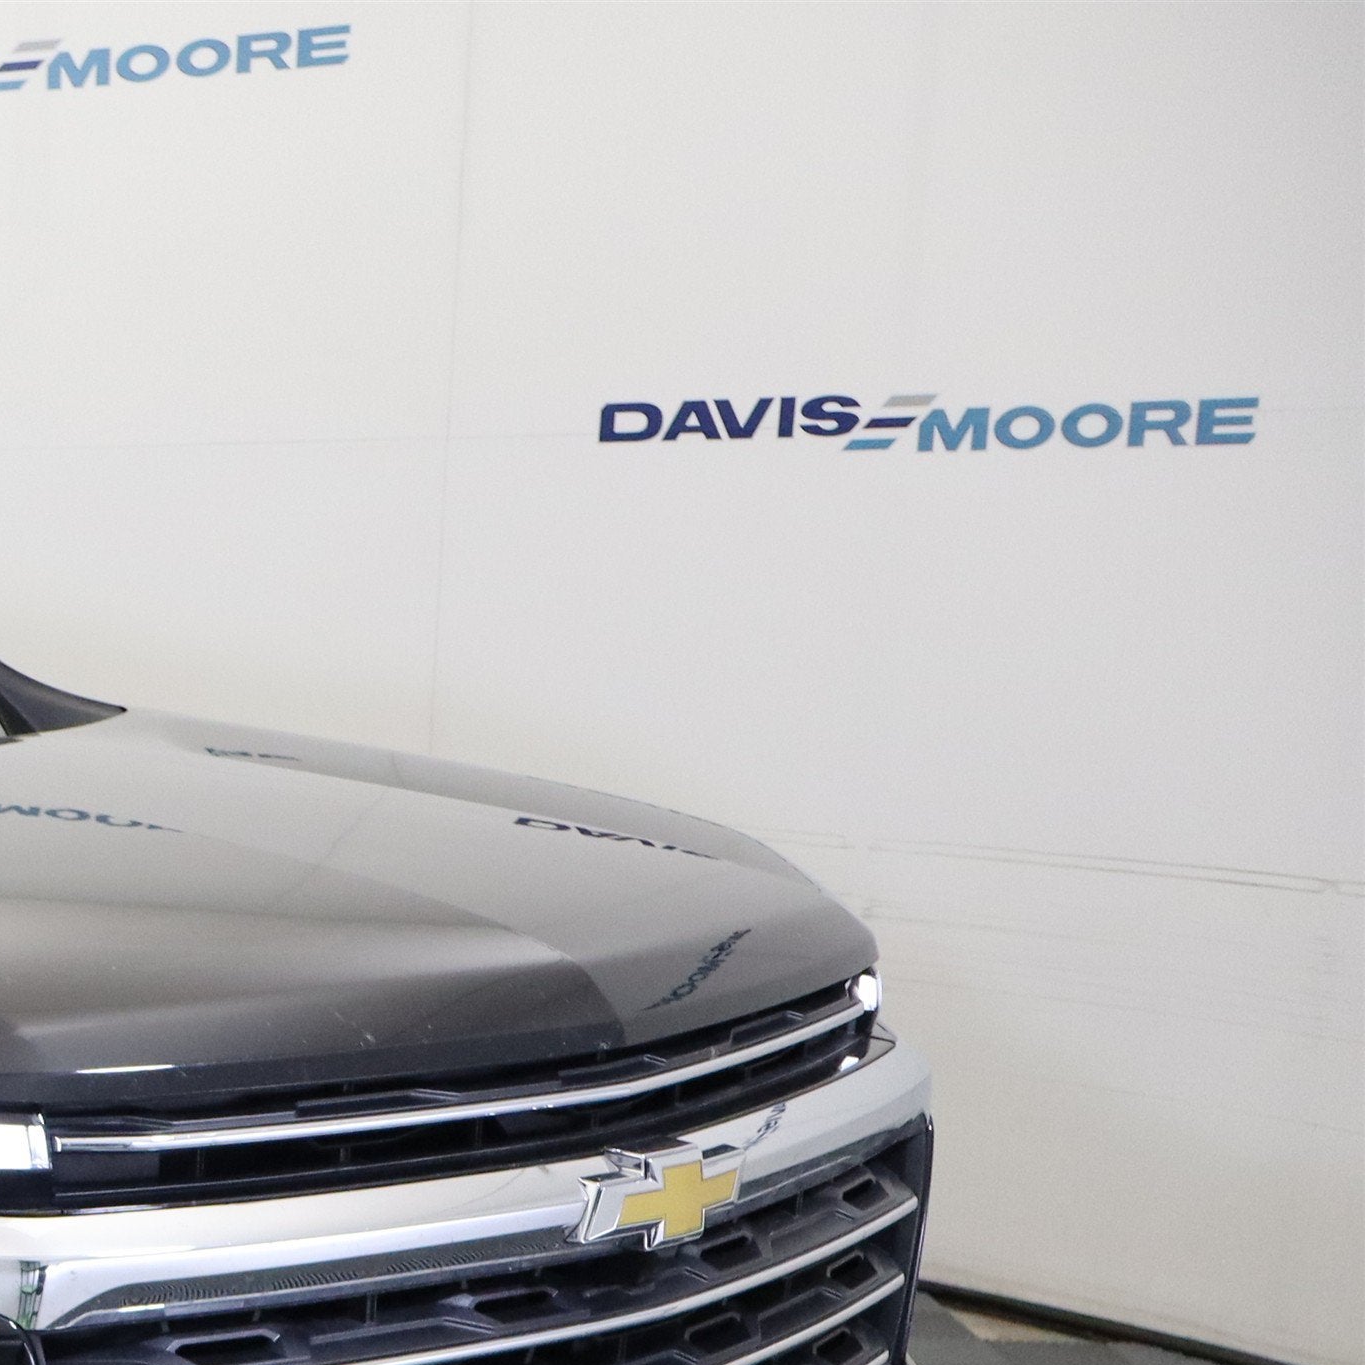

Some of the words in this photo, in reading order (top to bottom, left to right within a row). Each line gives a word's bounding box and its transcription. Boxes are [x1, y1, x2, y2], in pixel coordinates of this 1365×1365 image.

[46, 24, 352, 90] MOORE
[598, 394, 862, 443] DAVIS
[917, 397, 1260, 453] MOORE
